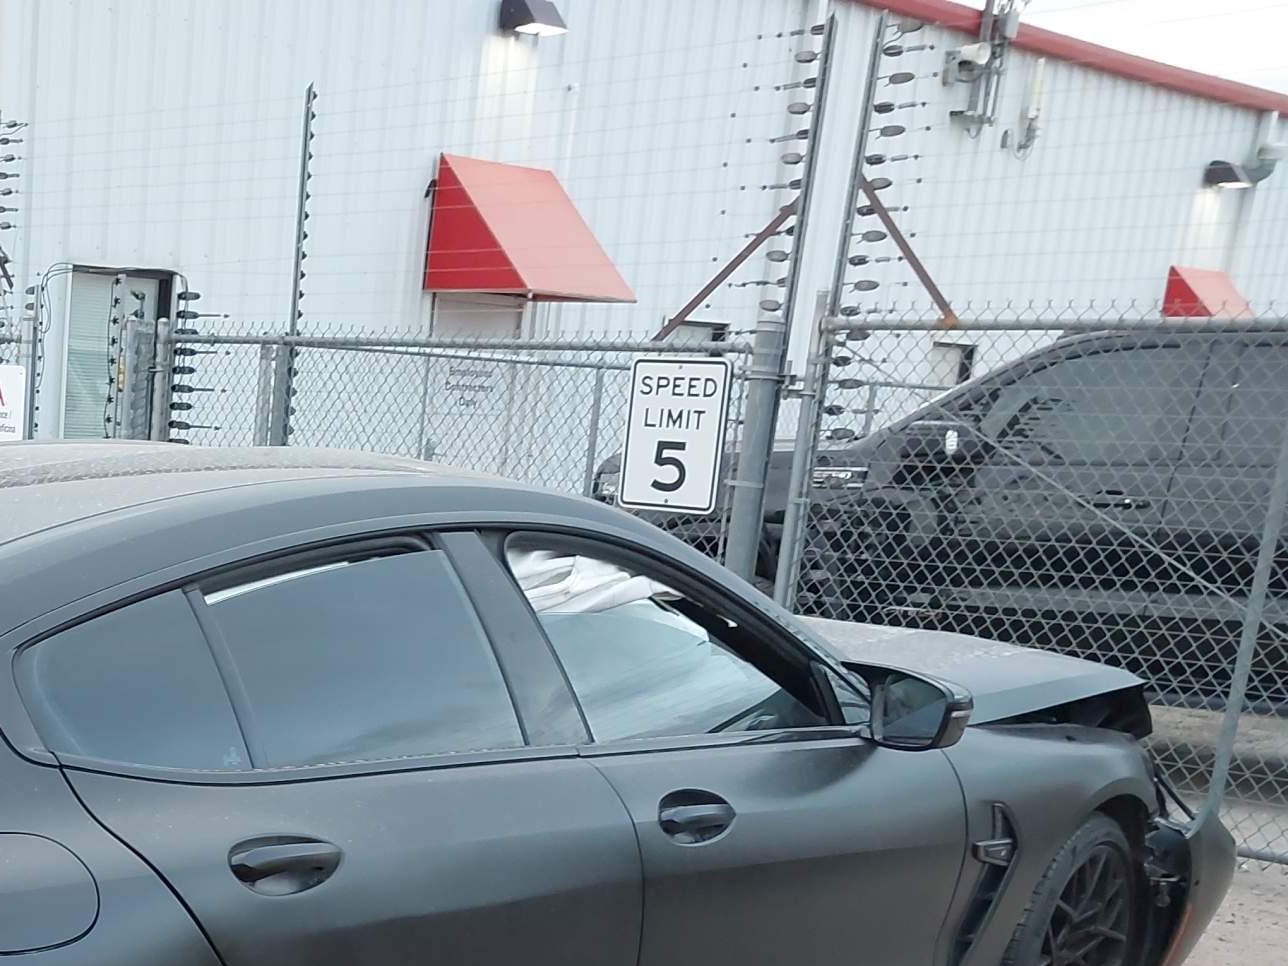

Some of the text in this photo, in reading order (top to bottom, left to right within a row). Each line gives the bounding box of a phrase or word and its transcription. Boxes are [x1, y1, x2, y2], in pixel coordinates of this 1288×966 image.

[640, 376, 718, 398] SPEED
[644, 407, 706, 430] LIMIT
[650, 440, 687, 492] 5
